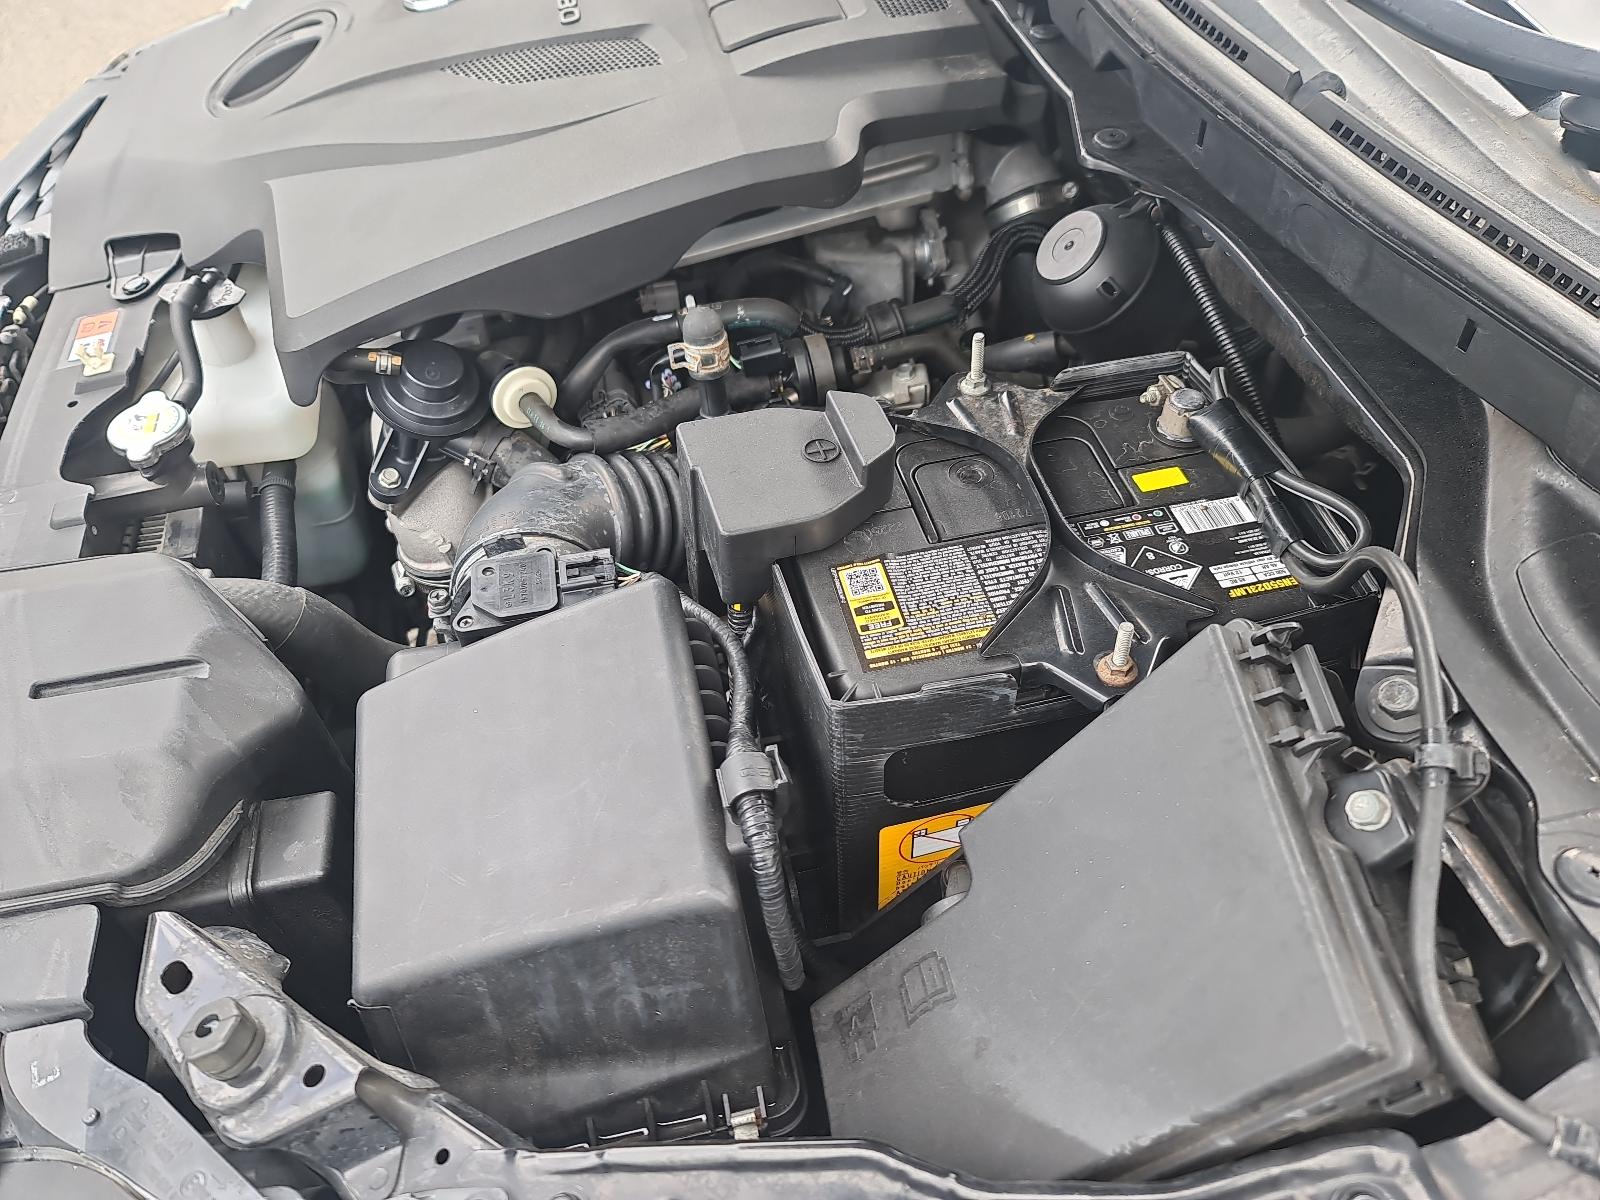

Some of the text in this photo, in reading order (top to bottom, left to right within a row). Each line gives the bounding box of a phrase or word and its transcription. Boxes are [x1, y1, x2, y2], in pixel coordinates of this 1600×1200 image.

[1001, 545, 1028, 553] COLLECTION
[1010, 553, 1038, 562] PHYSICIAN
[1145, 551, 1155, 560] 8
[979, 565, 1034, 580] FLUSH IMMEDIATELY
[998, 573, 1026, 582] CONTACTS
[984, 582, 1010, 591] CONTAINS
[1228, 576, 1299, 599] EN55D23LMF
[866, 619, 892, 630] FREE
